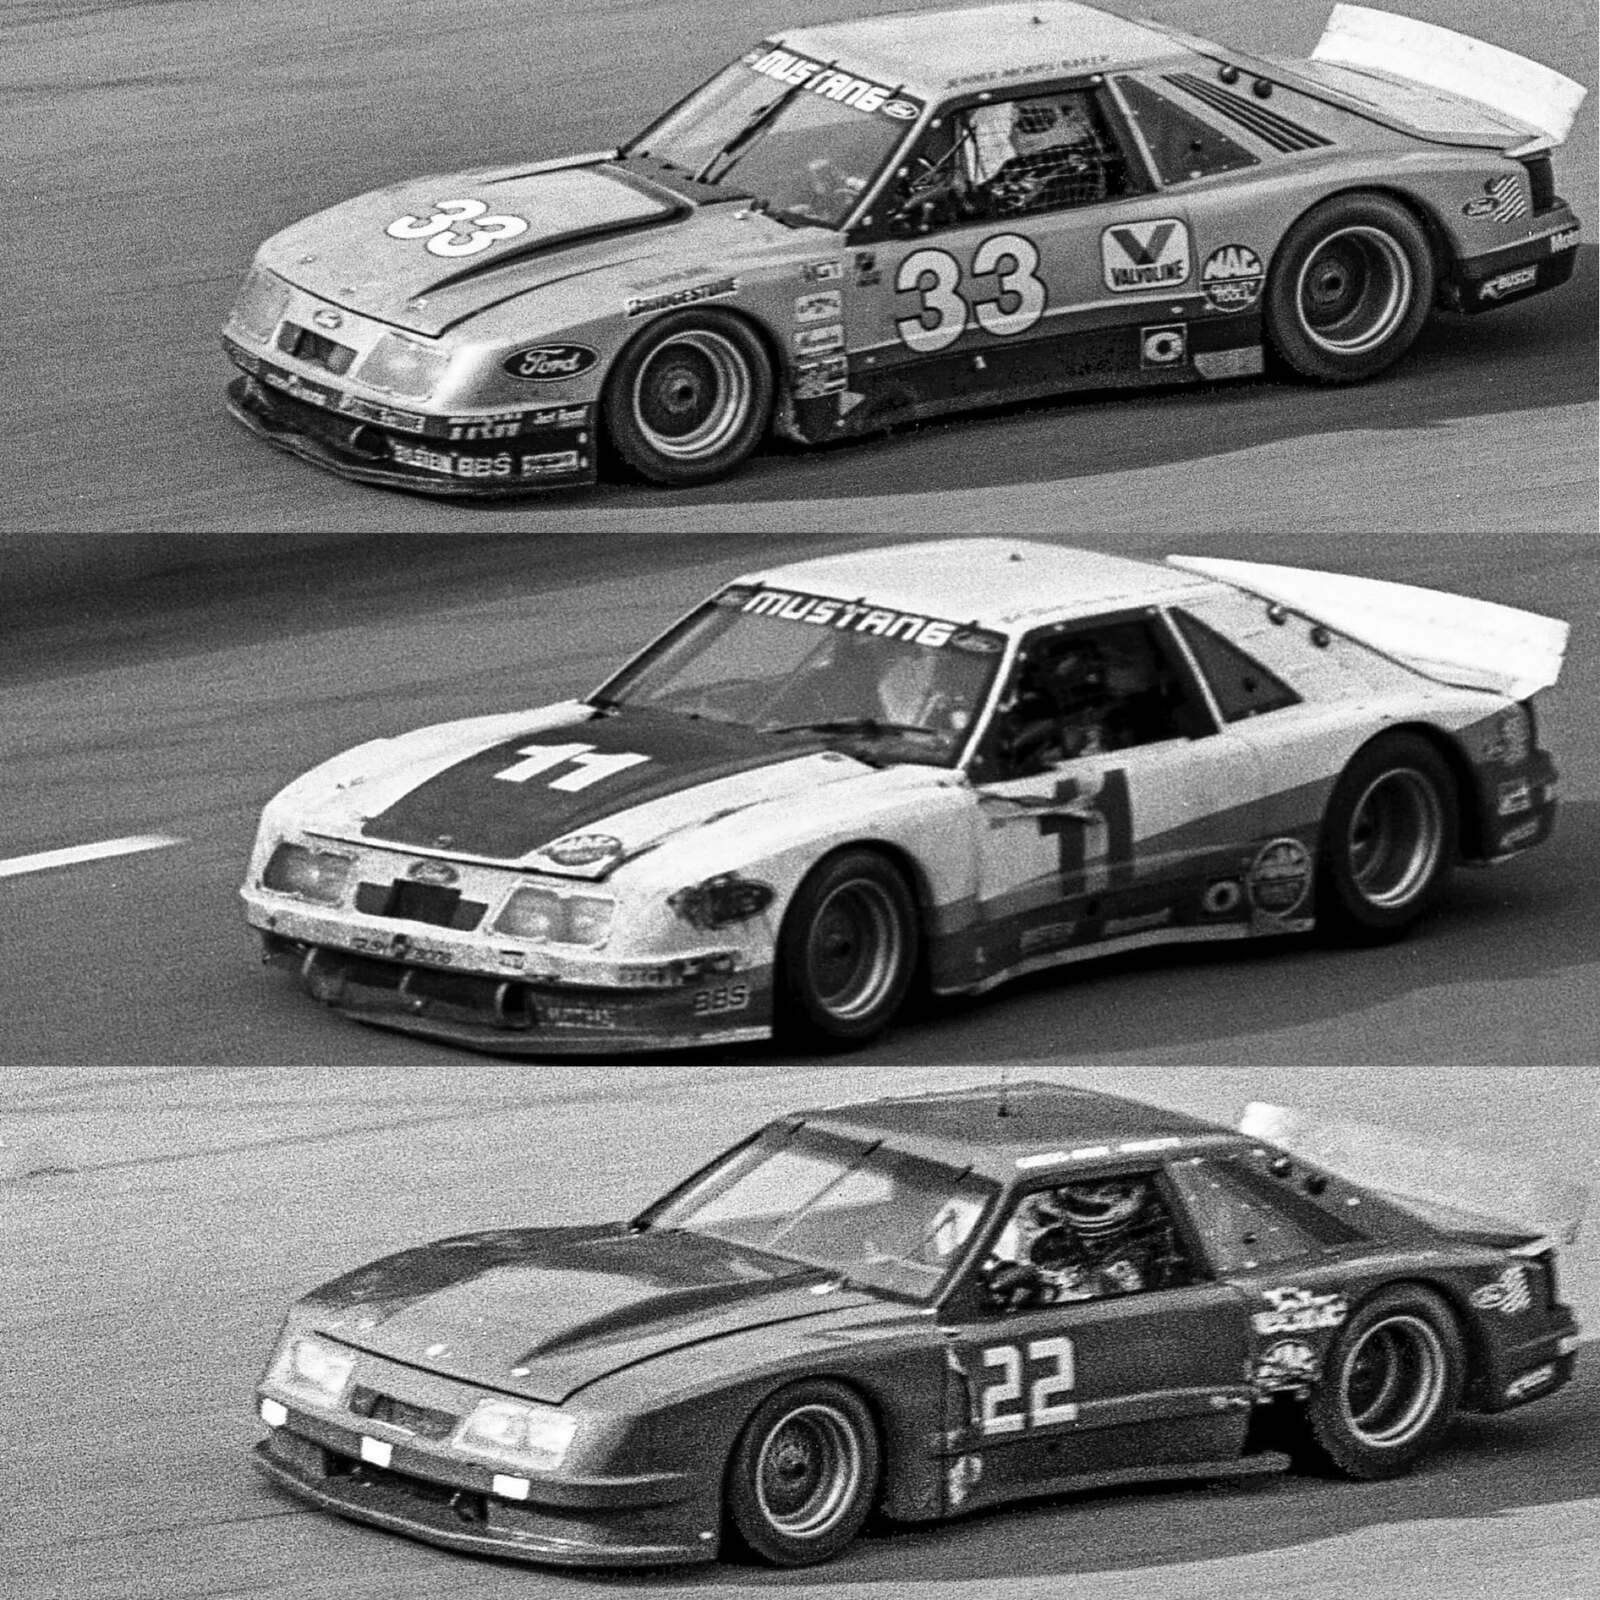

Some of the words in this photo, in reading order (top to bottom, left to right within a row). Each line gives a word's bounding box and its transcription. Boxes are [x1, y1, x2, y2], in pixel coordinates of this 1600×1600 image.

[752, 50, 890, 112] MUSTANG
[386, 199, 529, 258] 33
[896, 233, 1047, 353] 33
[1110, 260, 1184, 287] VALVOLINE
[519, 349, 581, 375] Ford
[458, 452, 512, 477] BBS
[741, 591, 958, 648] MUSTANG
[493, 743, 653, 793] 11
[982, 1336, 1079, 1436] 22
